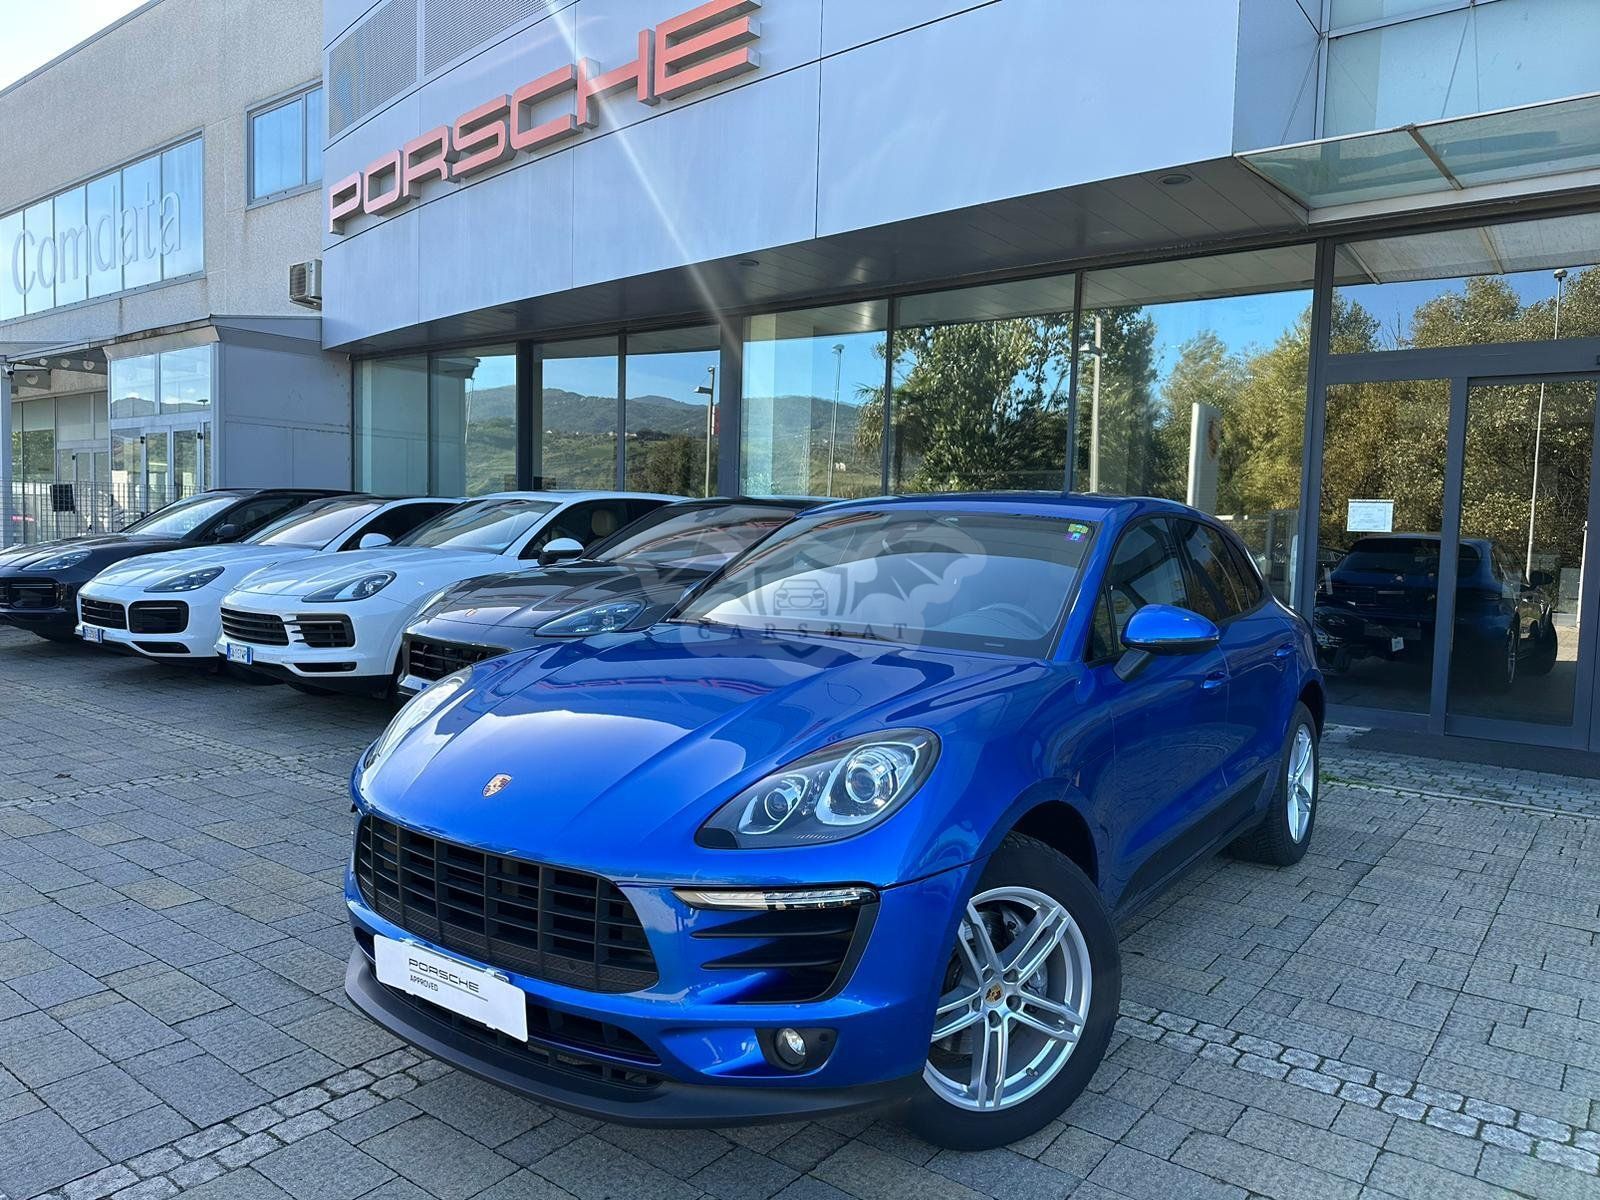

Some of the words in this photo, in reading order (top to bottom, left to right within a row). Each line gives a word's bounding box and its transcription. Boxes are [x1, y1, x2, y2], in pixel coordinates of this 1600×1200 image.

[328, 0, 761, 234] PORSCHE
[12, 181, 181, 296] Comdata
[408, 957, 480, 993] PORSCHE
[410, 974, 439, 992] APPROVED
